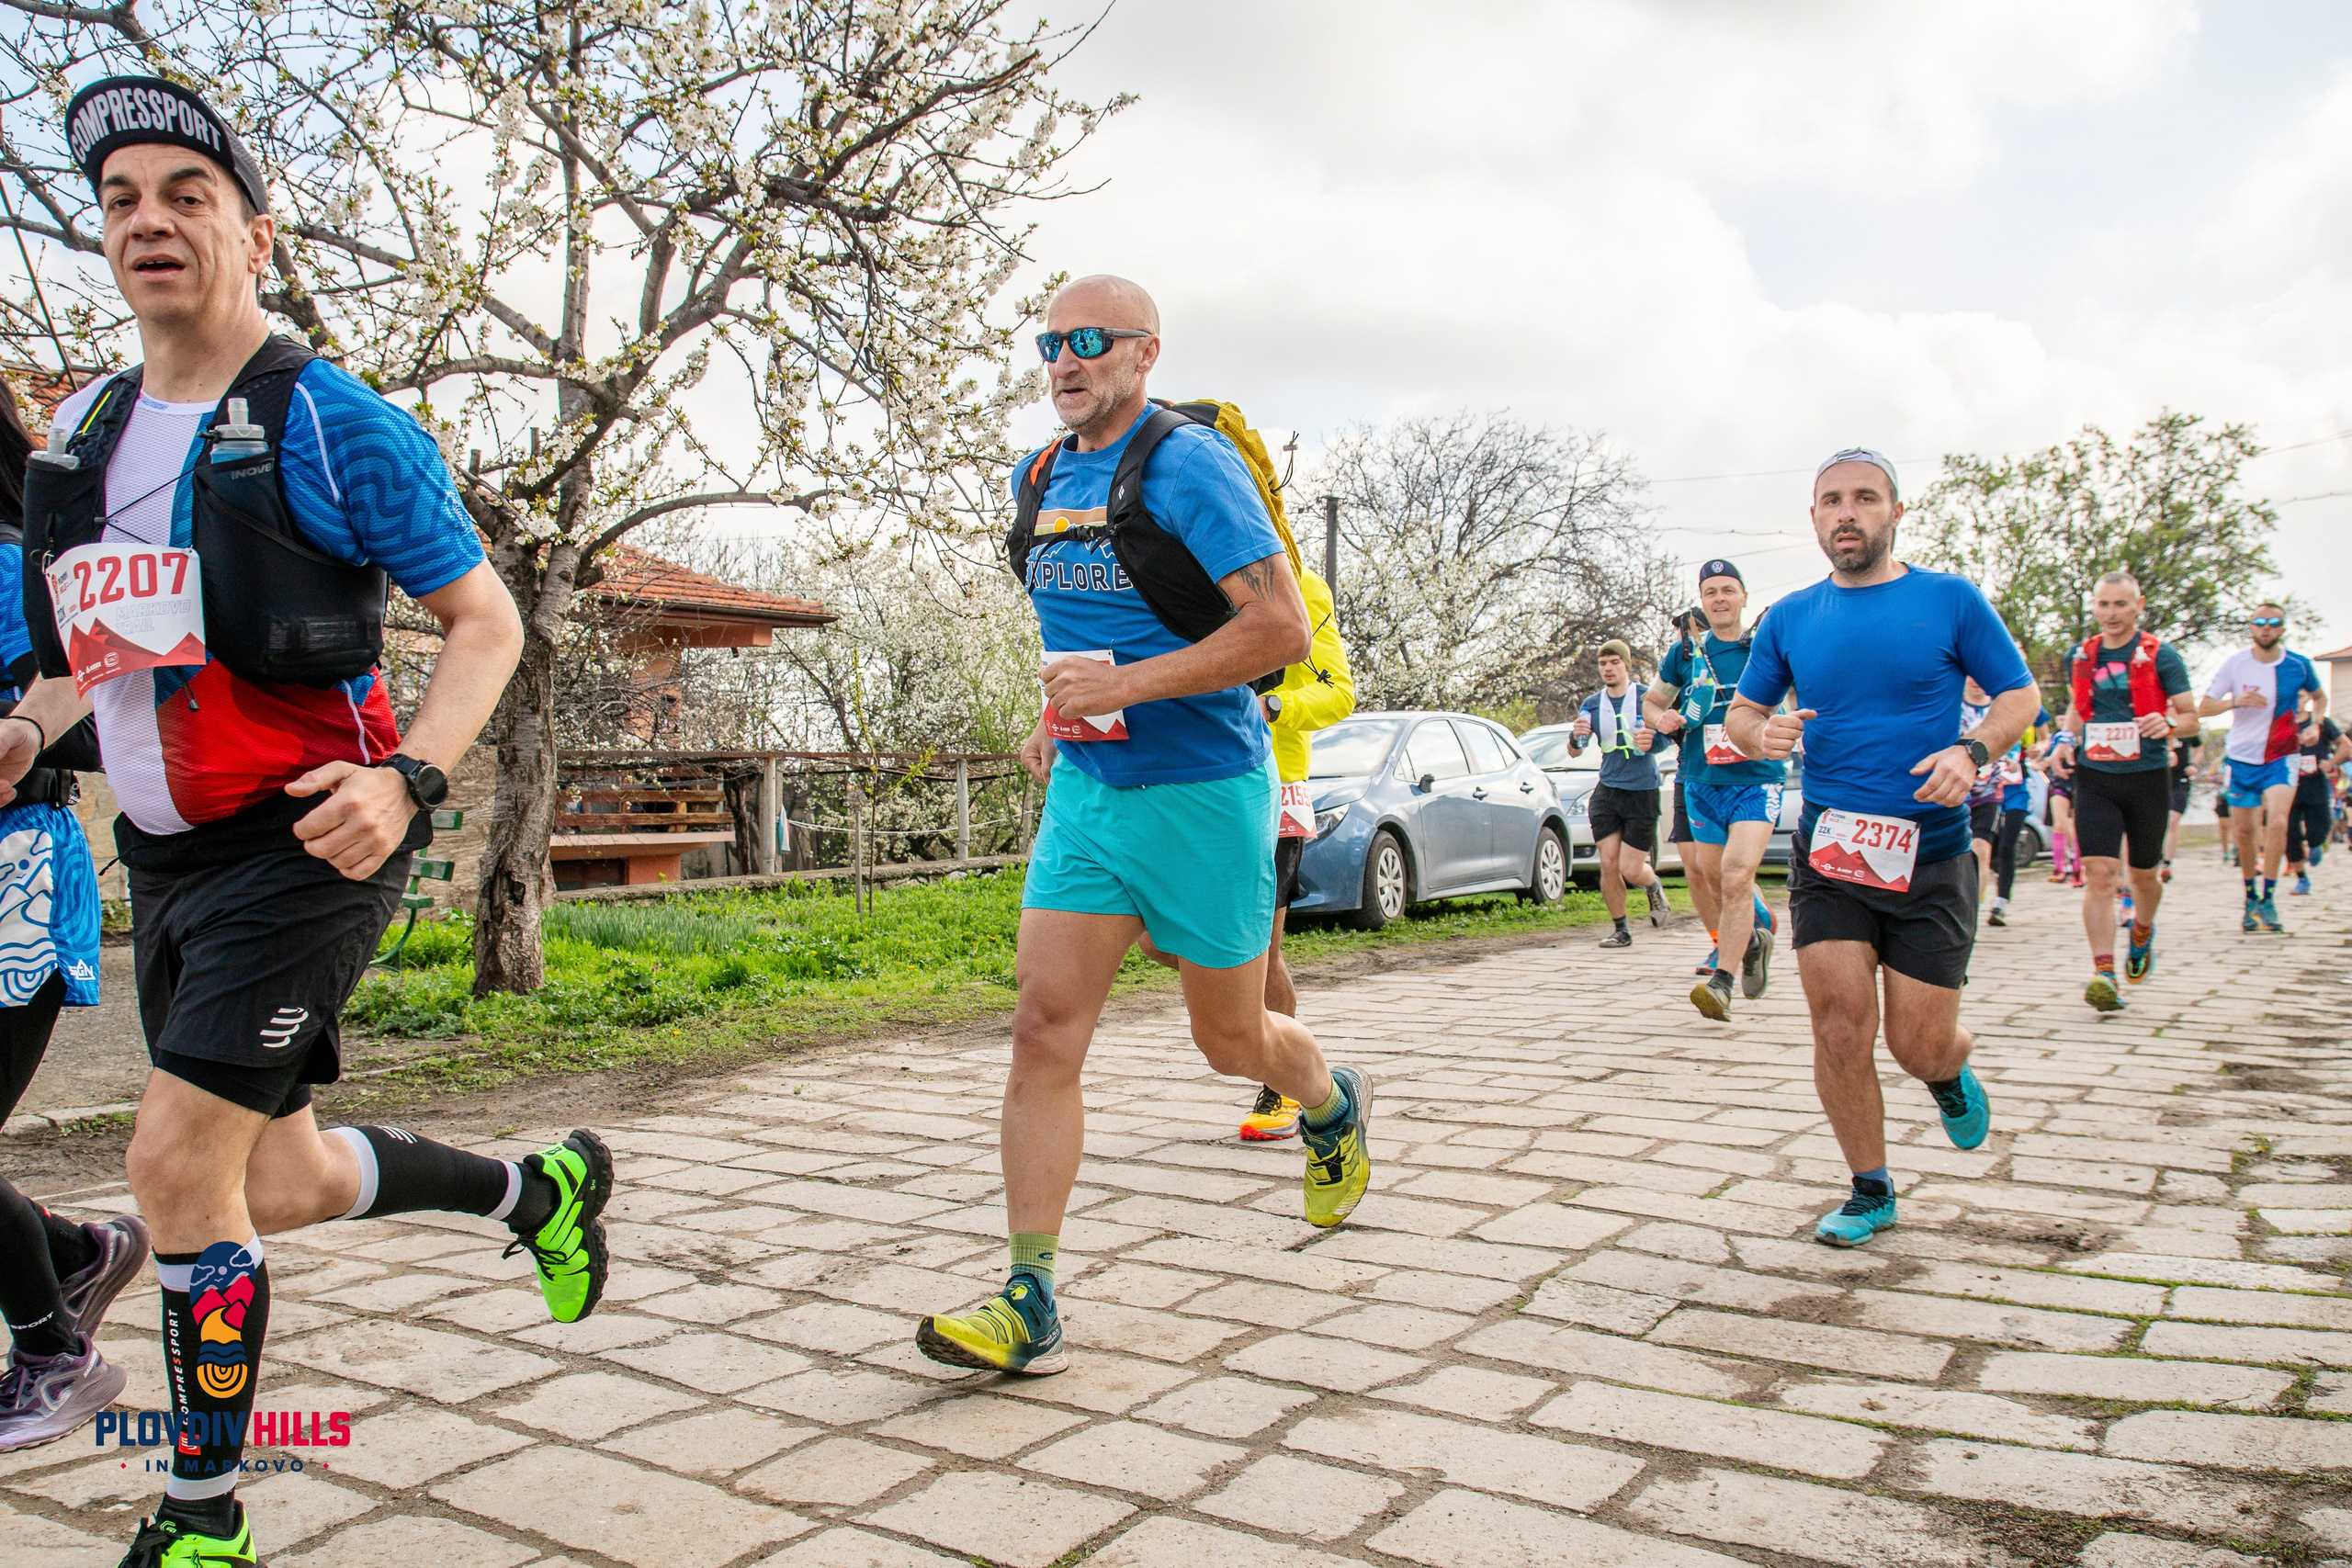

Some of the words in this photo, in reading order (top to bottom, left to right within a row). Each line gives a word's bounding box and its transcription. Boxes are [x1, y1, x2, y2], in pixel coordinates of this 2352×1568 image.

[71, 87, 221, 164] COMPRESSPORT
[74, 552, 189, 613] 2207
[116, 599, 191, 622] MARKOVO
[116, 617, 155, 635] TRAIL
[2105, 727, 2134, 741] 2217
[1281, 784, 1312, 807] 2159
[1851, 818, 1912, 854] 2374
